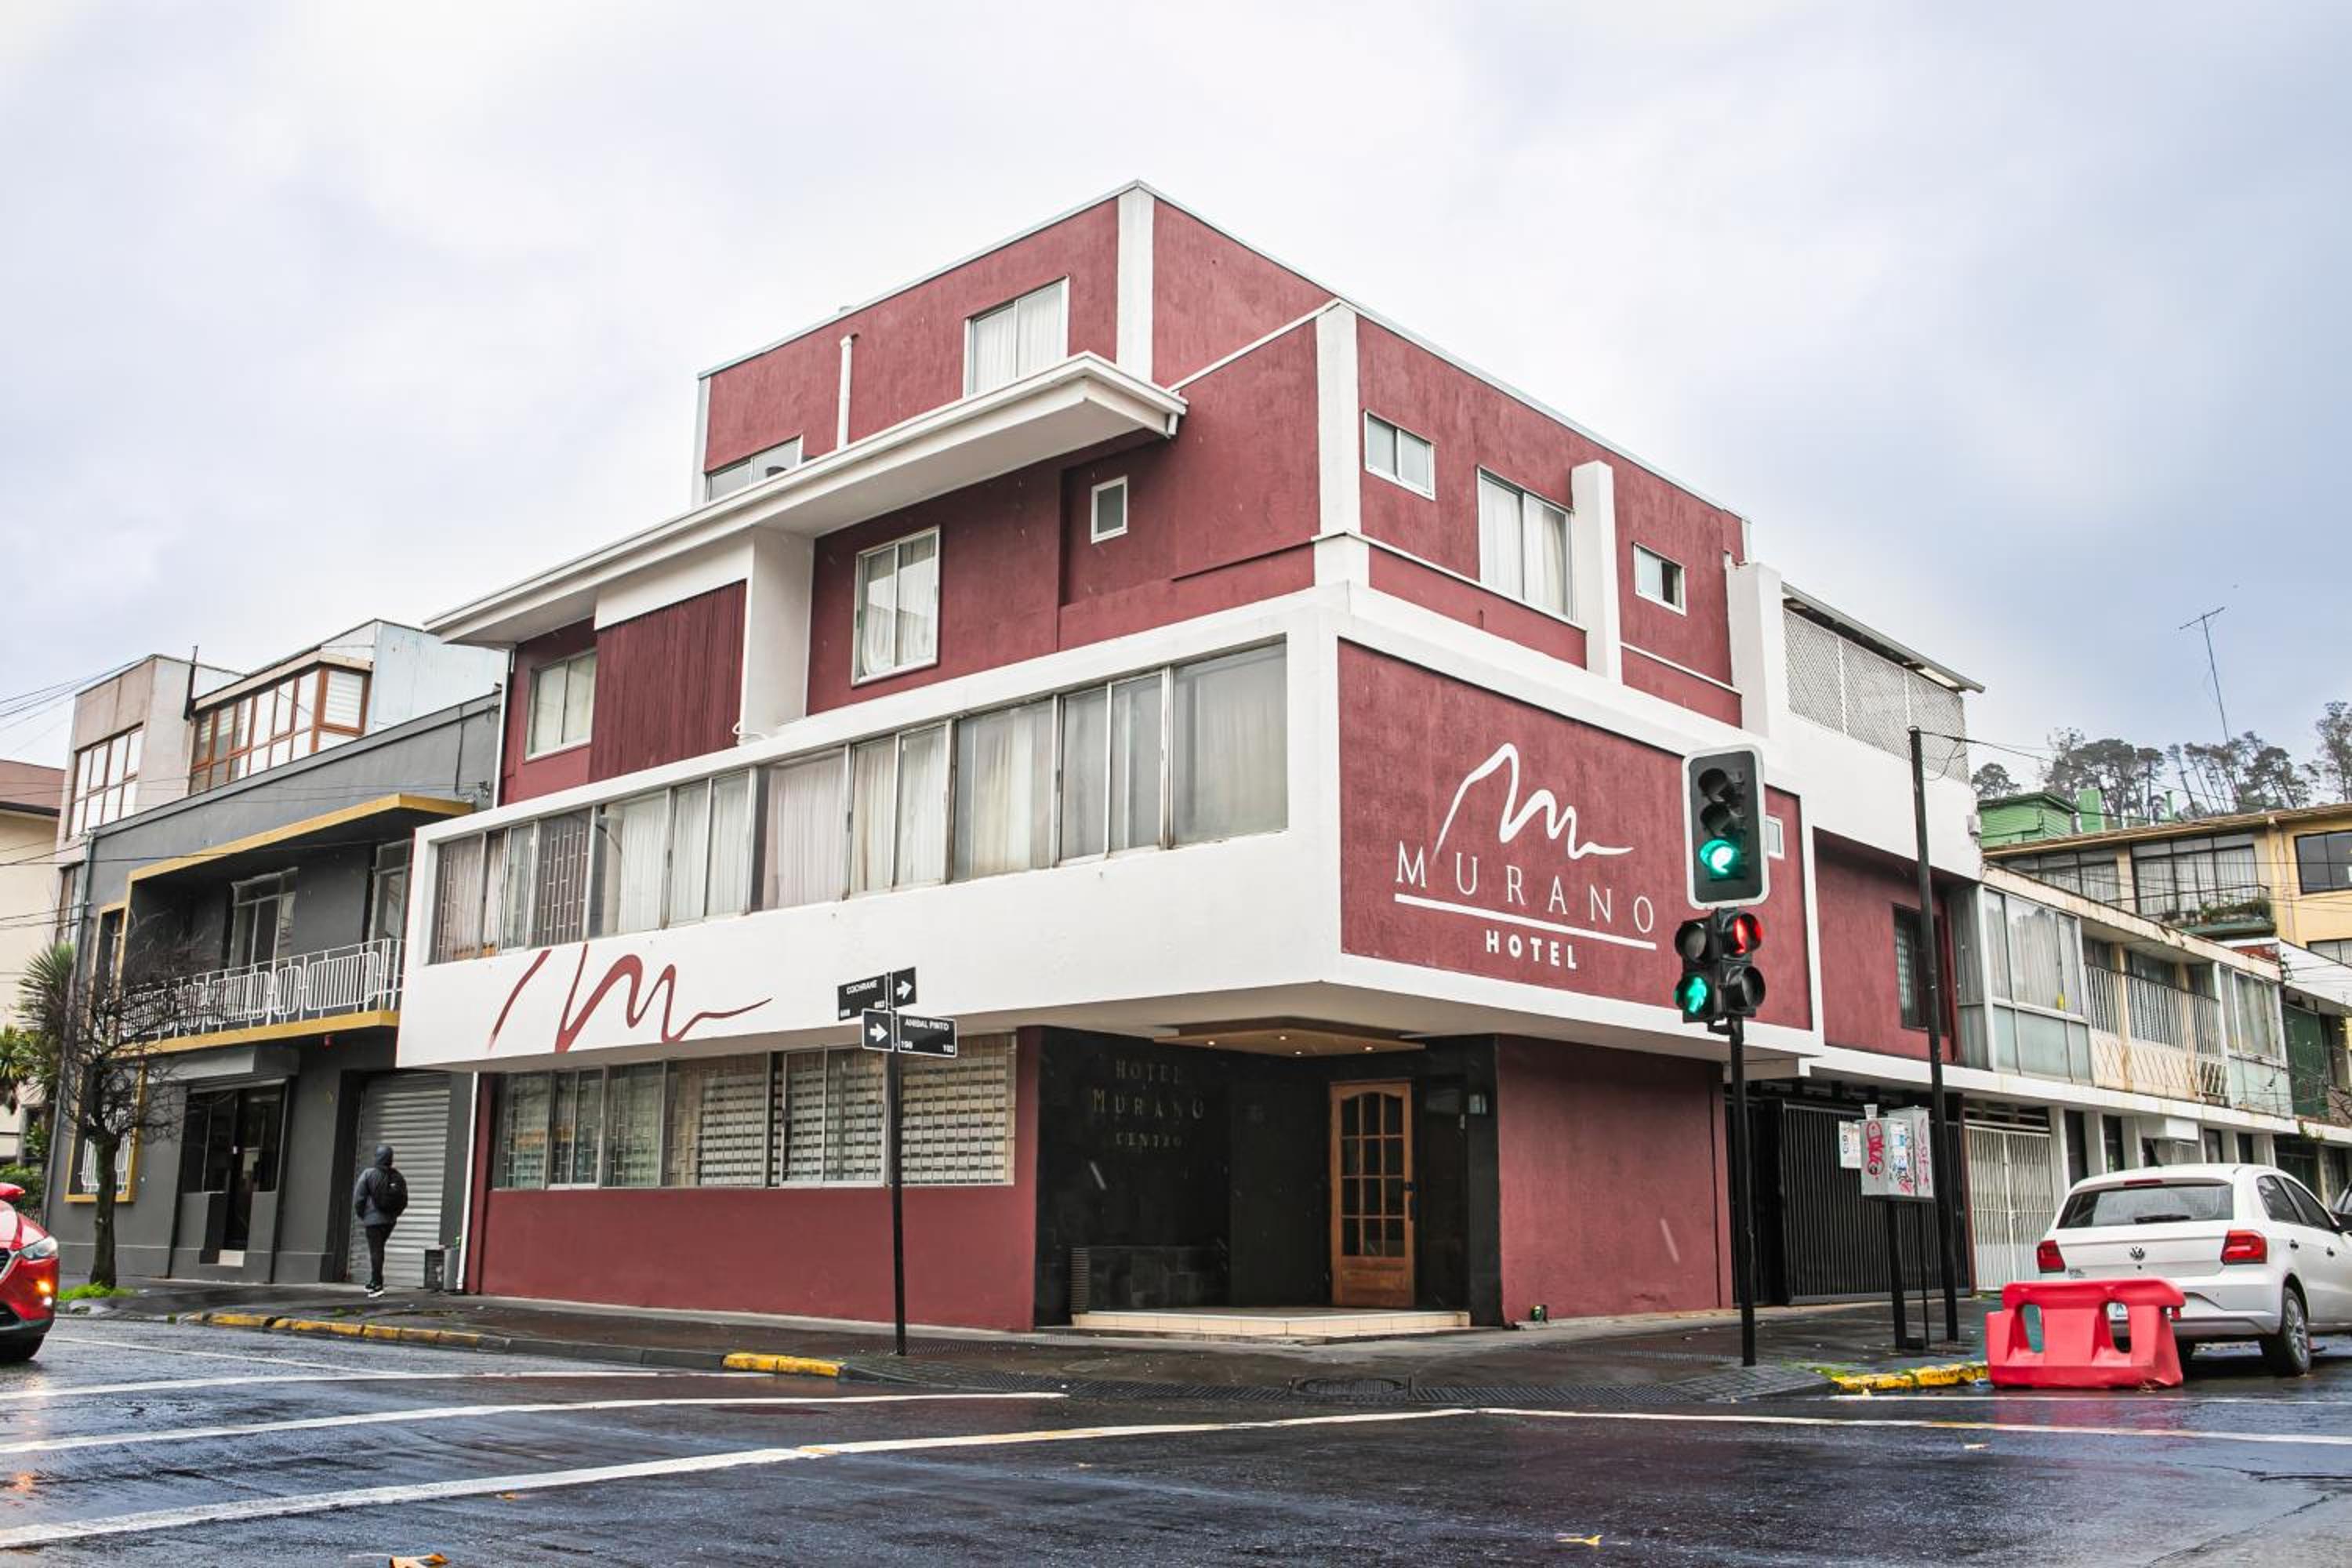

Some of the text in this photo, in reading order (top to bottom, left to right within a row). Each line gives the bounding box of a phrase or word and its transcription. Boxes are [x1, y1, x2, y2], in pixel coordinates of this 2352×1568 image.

[1396, 840, 1655, 934] MURANO
[1485, 930, 1577, 970] HOTEL
[1116, 1059, 1181, 1084] HOTEL
[1093, 1088, 1205, 1120] MURANO
